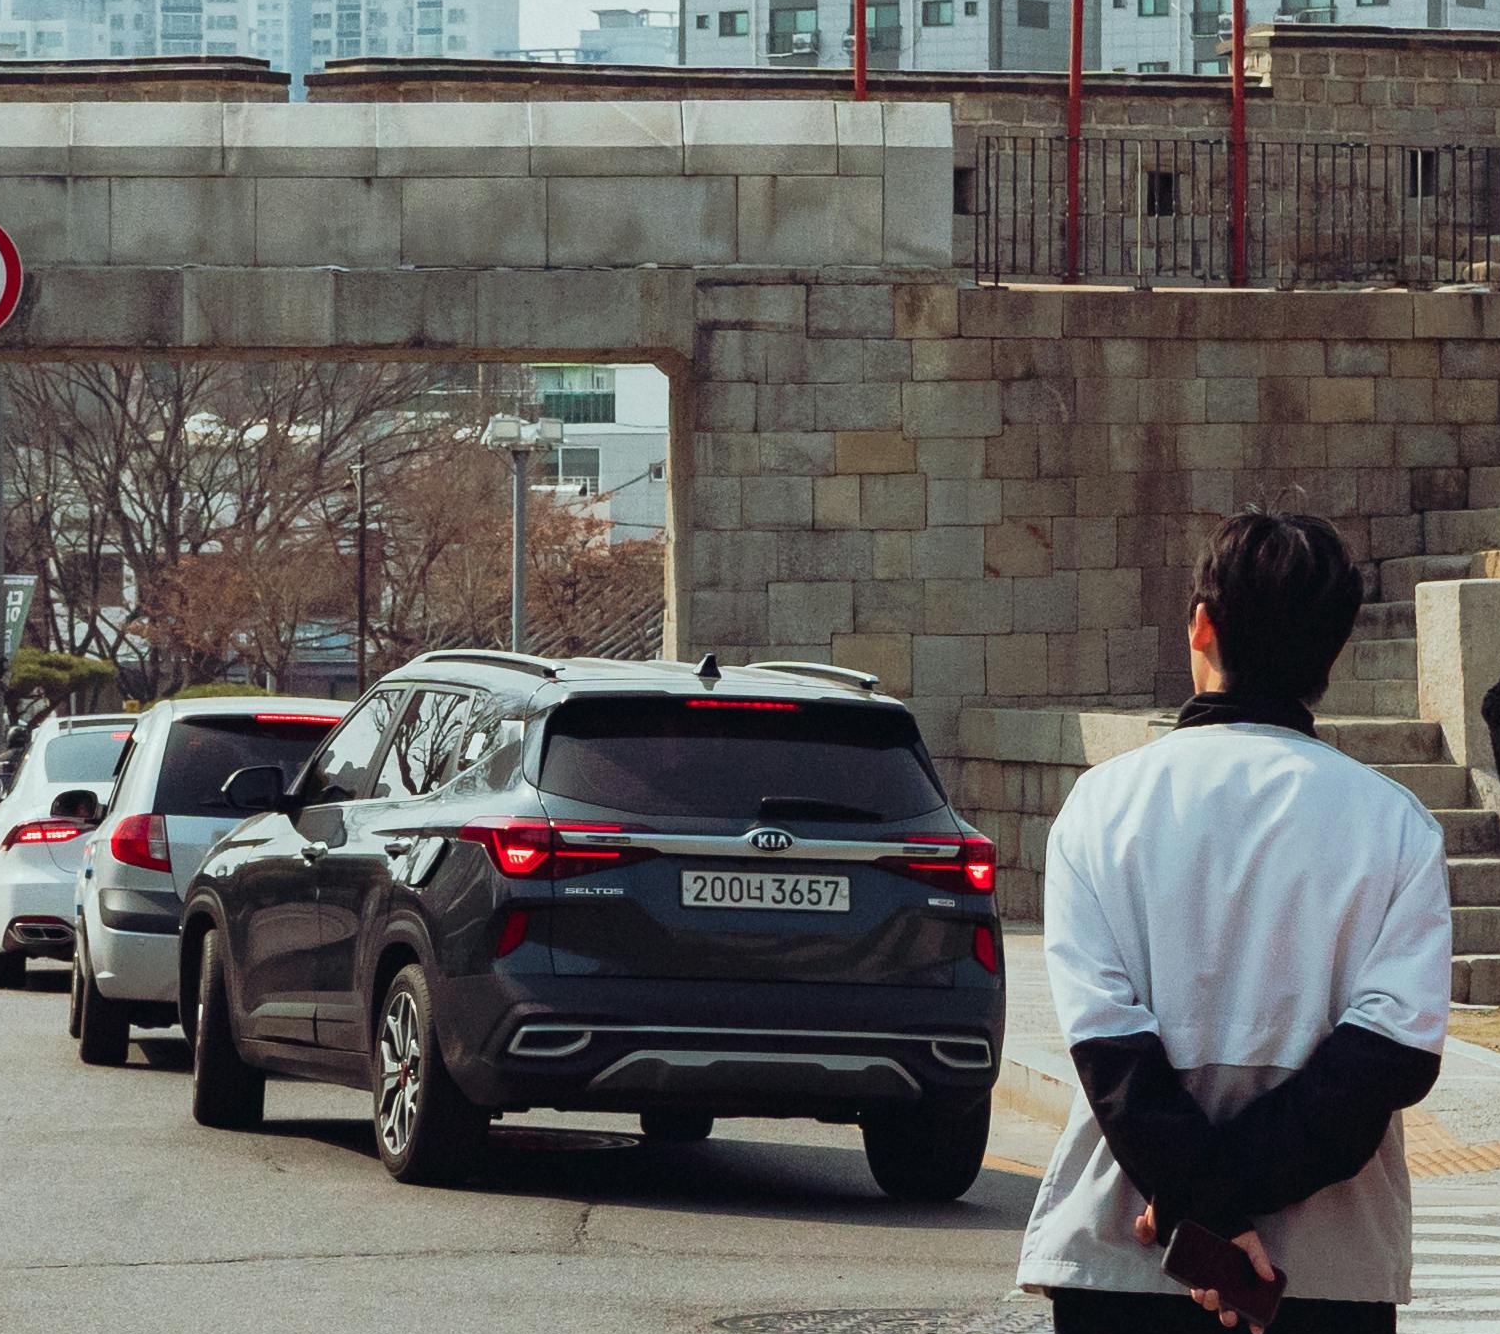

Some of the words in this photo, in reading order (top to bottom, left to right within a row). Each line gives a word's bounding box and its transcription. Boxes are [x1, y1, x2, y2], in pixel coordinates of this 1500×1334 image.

[757, 833, 789, 848] KIA
[564, 887, 624, 895] SELTOS
[692, 875, 764, 903] 200너
[771, 878, 840, 907] 3657
